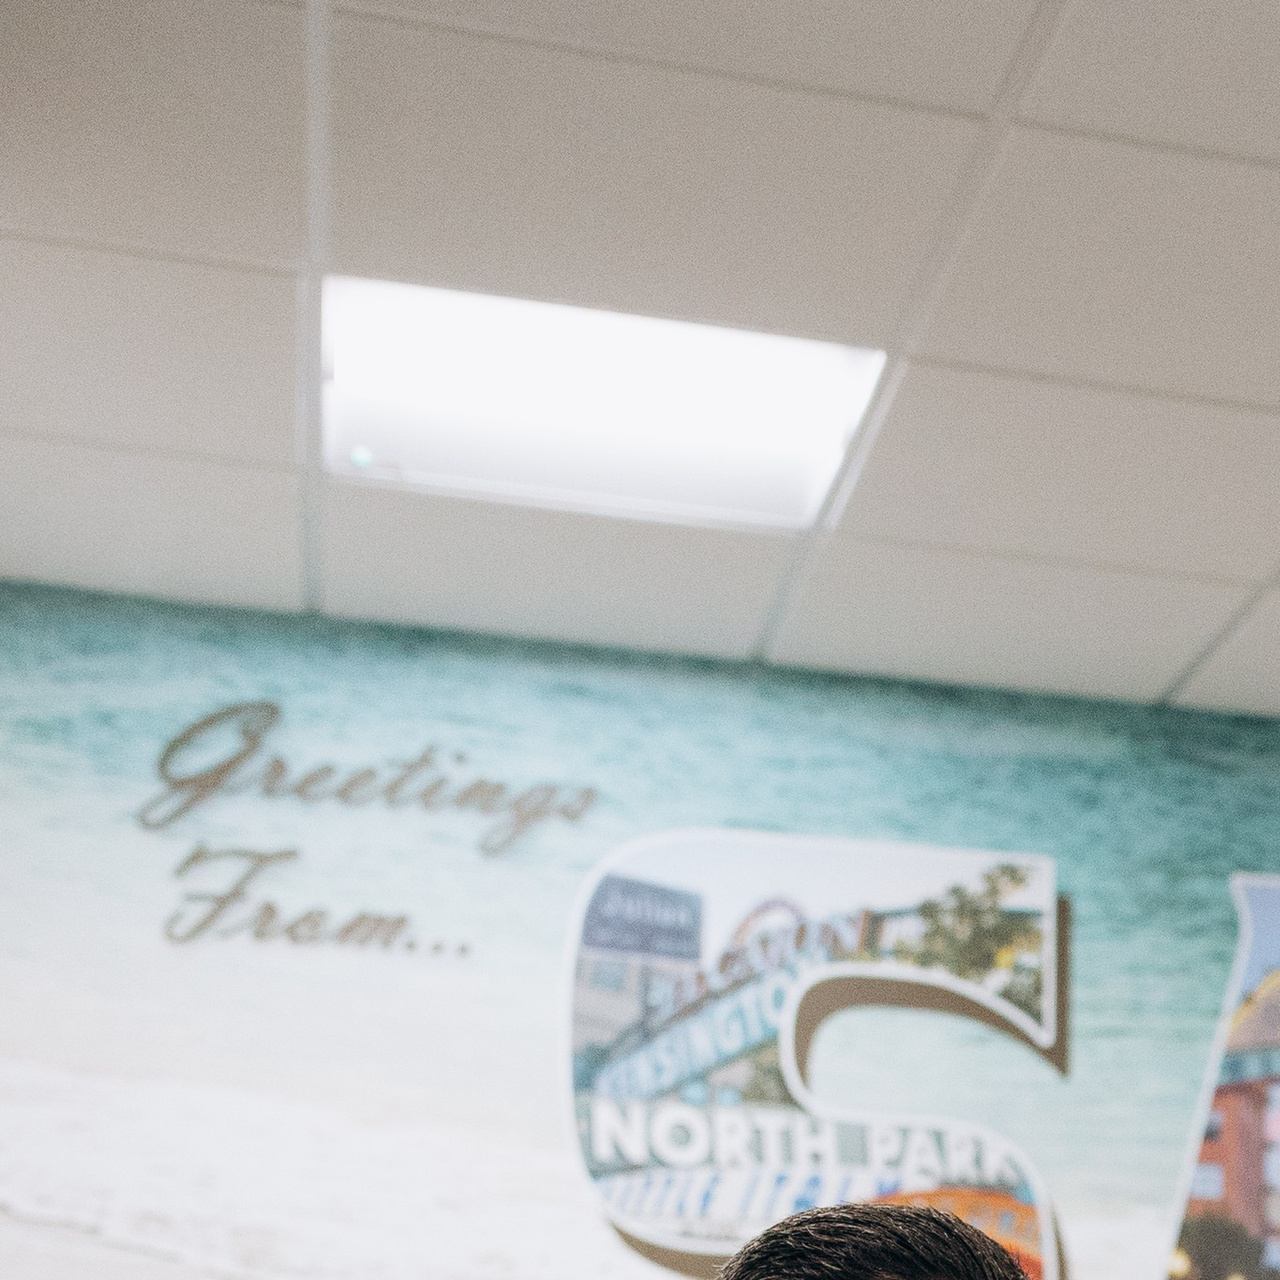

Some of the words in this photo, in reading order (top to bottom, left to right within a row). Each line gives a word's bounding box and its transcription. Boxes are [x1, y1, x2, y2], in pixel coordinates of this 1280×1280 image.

[136, 700, 600, 859] Greetings
[164, 841, 473, 959] From...
[590, 1098, 841, 1170] NORTH
